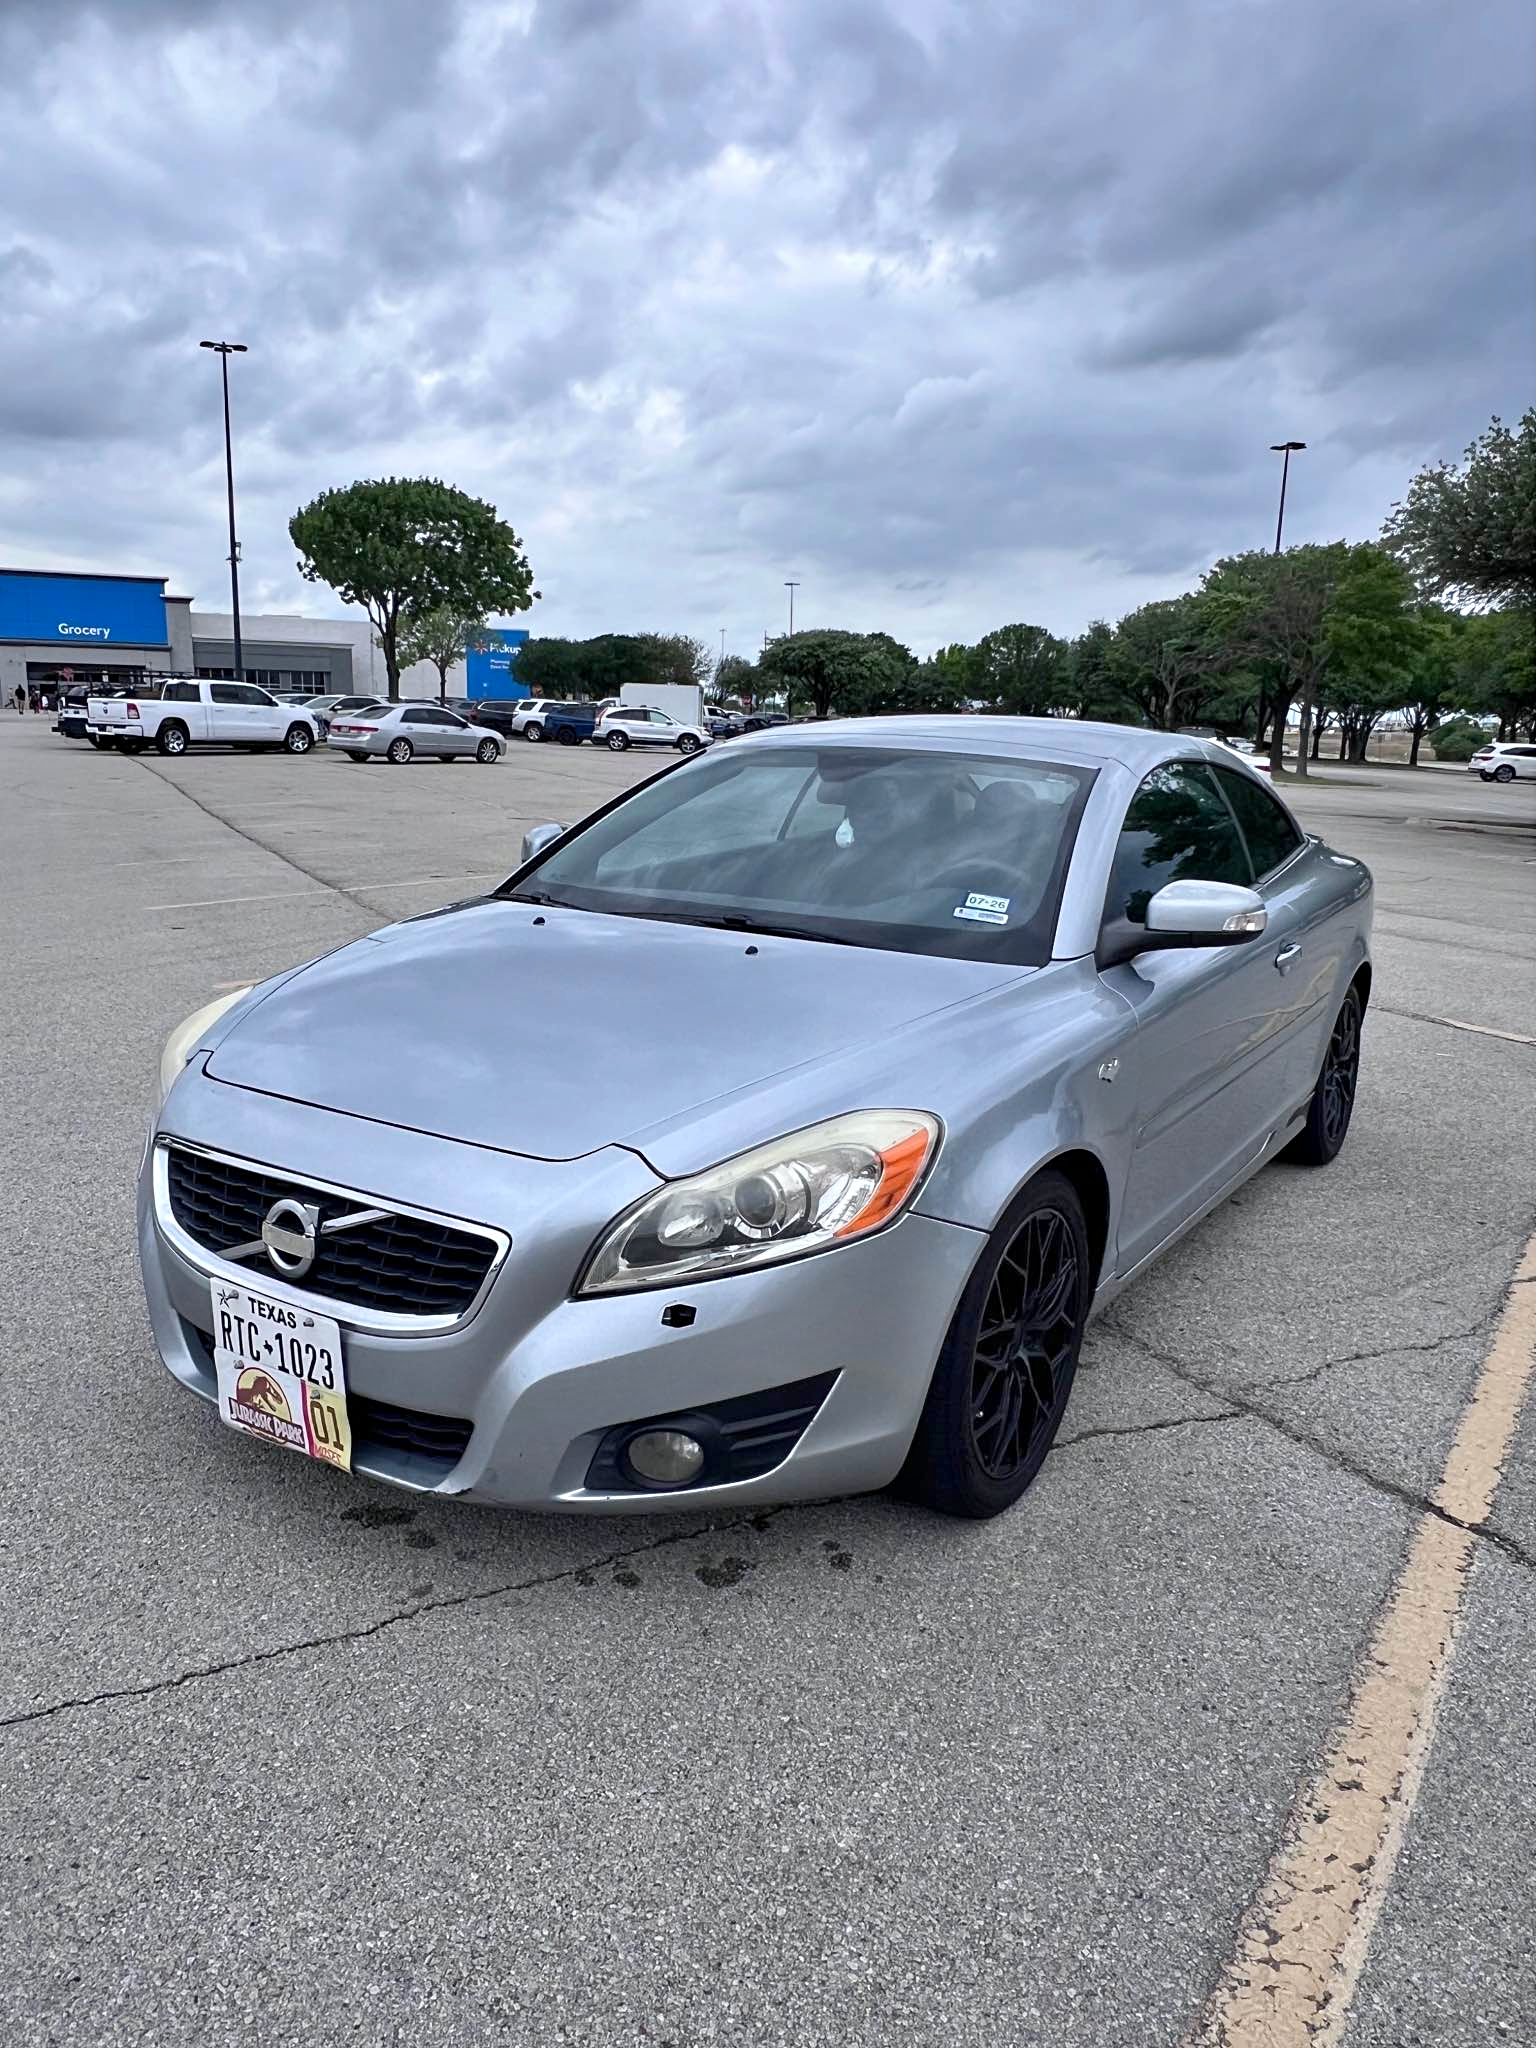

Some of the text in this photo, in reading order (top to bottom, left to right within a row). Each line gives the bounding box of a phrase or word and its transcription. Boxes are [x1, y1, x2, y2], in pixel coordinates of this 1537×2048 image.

[58, 623, 110, 639] Grocery
[969, 896, 1006, 909] 07-26
[248, 1296, 297, 1329] TEXAS
[220, 1310, 334, 1390] RTC 1023
[230, 1399, 305, 1445] JURASSIC PARK
[310, 1400, 344, 1451] 01
